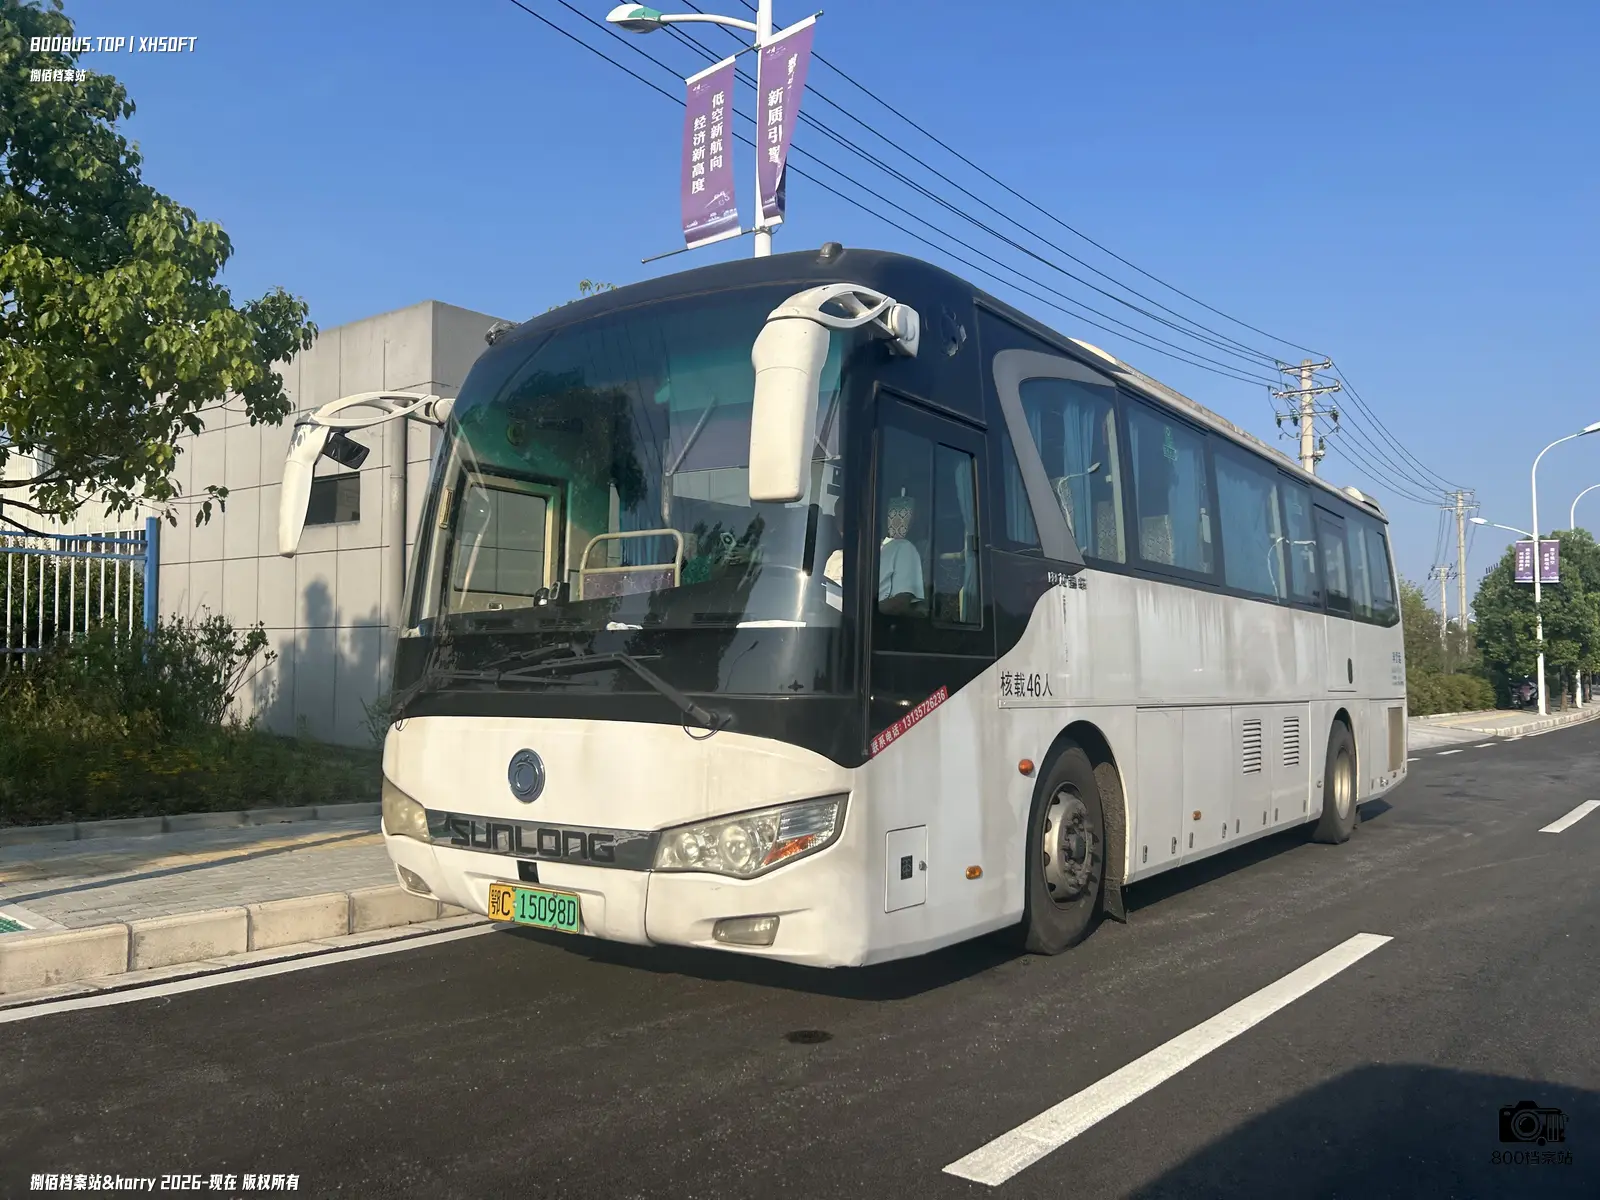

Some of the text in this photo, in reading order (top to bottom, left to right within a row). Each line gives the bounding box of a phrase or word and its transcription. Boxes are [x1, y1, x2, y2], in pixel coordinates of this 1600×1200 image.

[691, 115, 707, 195] 经济新高度
[709, 91, 725, 173] 低空新航向
[1000, 671, 1053, 698] 核载46人
[450, 818, 616, 863] SUNLONG
